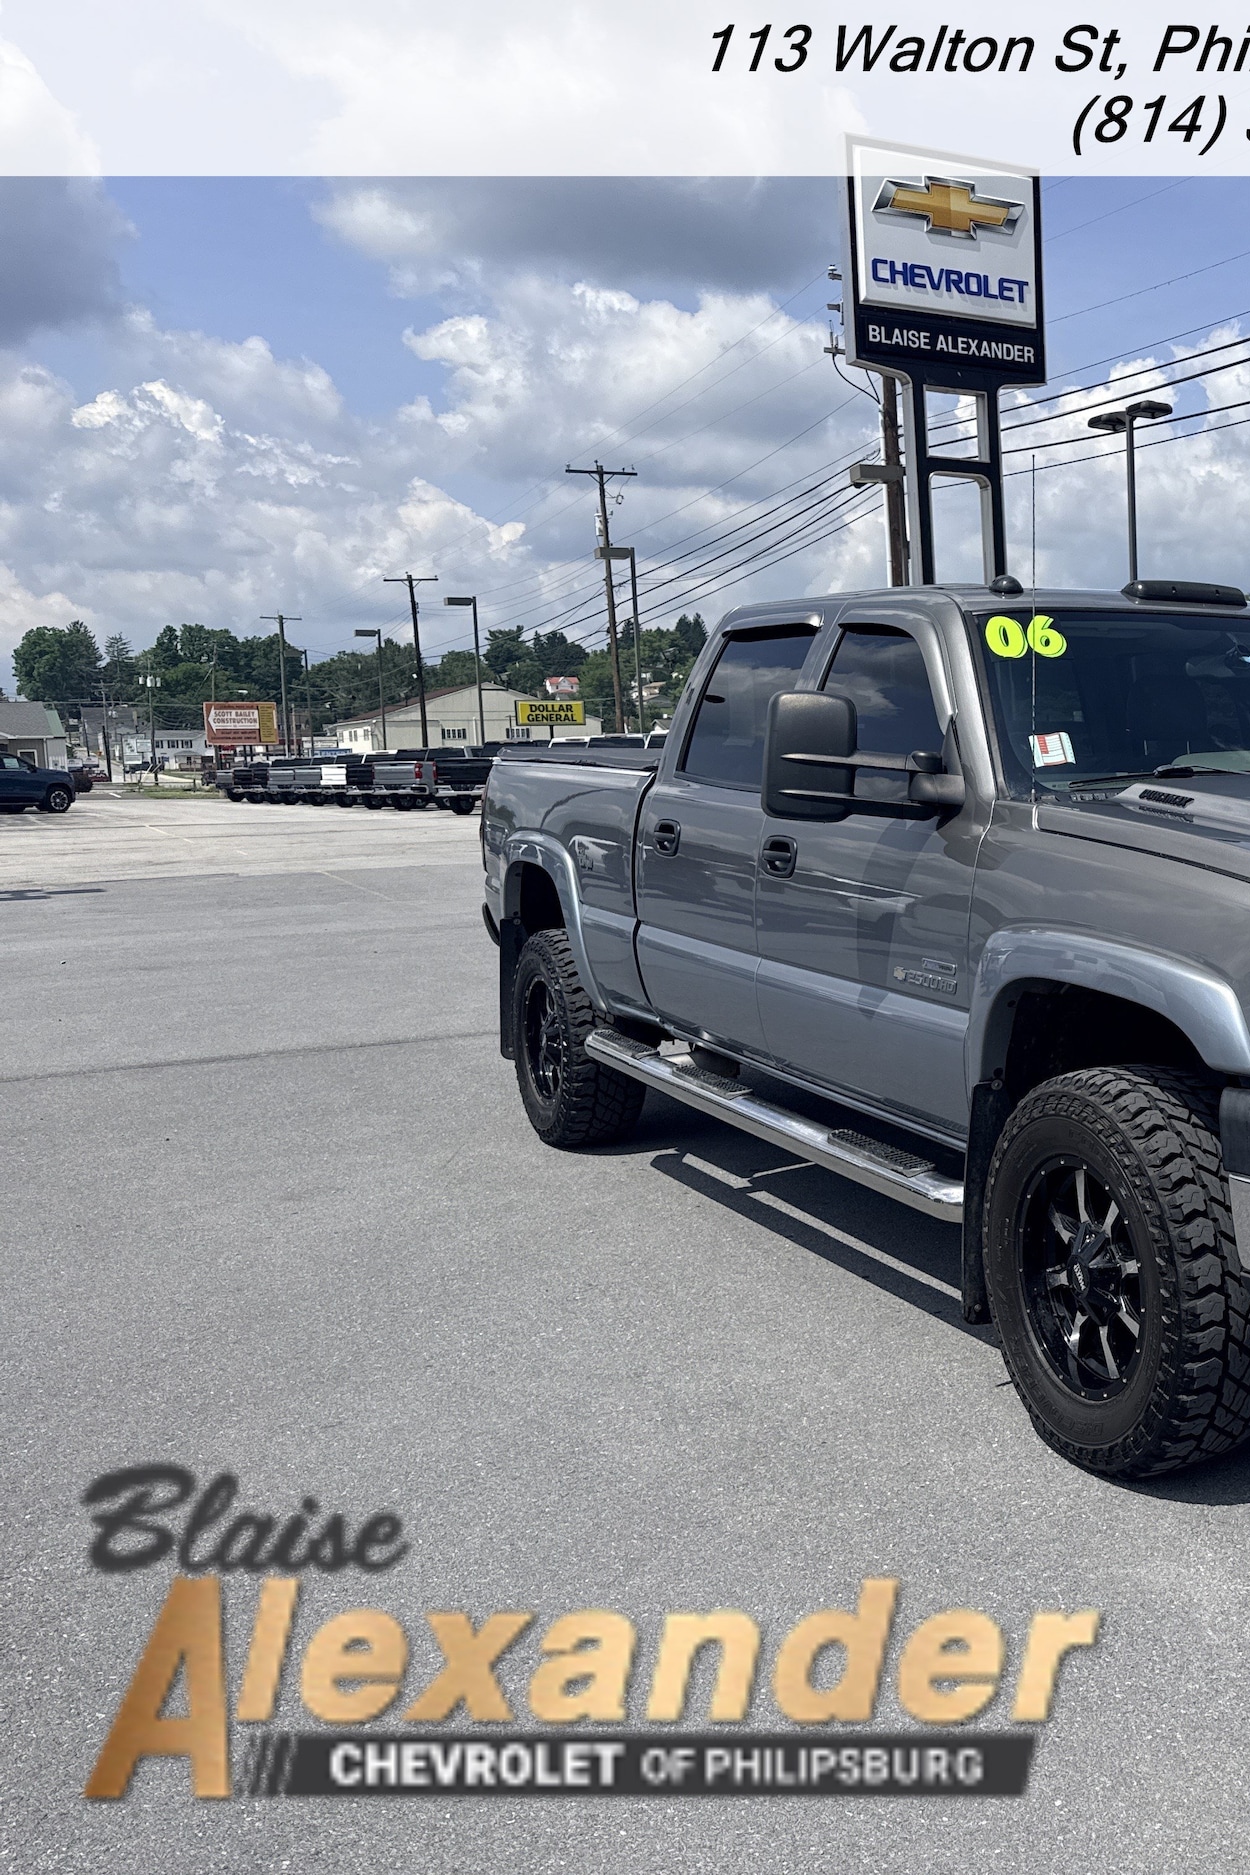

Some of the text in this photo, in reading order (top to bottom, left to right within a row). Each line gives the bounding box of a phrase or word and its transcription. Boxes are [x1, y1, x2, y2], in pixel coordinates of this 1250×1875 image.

[871, 258, 1029, 303] CHEVROLET
[867, 324, 1035, 364] BLAISE ALEXANDER
[985, 614, 1067, 658] 06
[527, 713, 577, 722] GENERAL
[529, 704, 574, 713] DOLLAR
